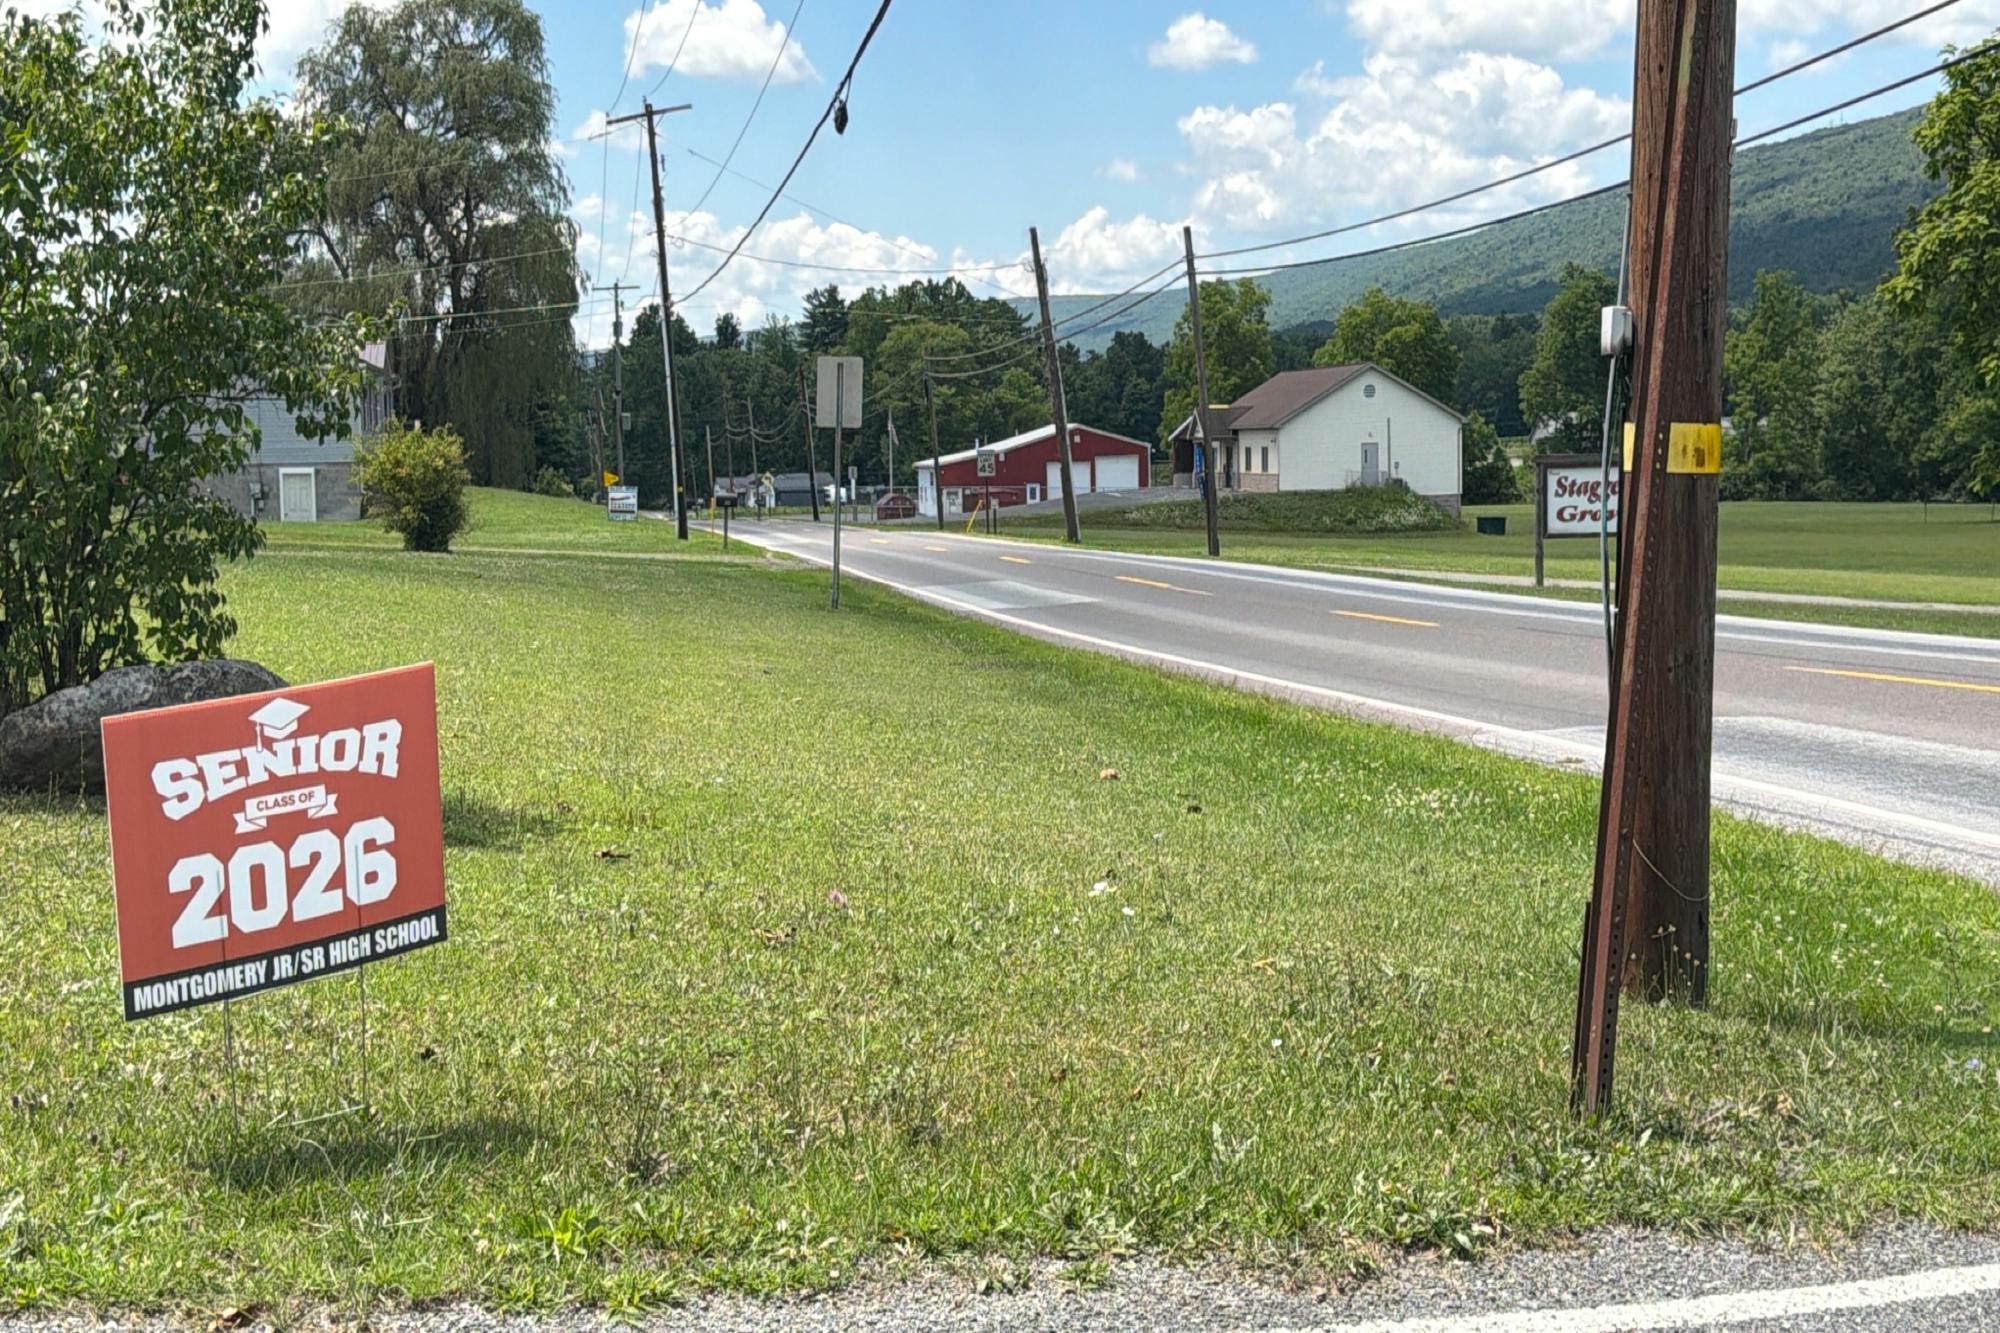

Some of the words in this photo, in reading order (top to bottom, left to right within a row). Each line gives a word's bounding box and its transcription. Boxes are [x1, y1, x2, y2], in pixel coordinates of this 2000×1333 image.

[979, 463, 994, 474] 45
[151, 718, 402, 821] SENIOR
[256, 795, 295, 812] CLASS
[298, 790, 315, 803] OF
[168, 816, 397, 949] 2026
[133, 959, 267, 1013] MONTGOMERY
[272, 946, 325, 981] JR/SR
[329, 933, 371, 966] HIGH
[374, 914, 439, 953] SCHOOL
